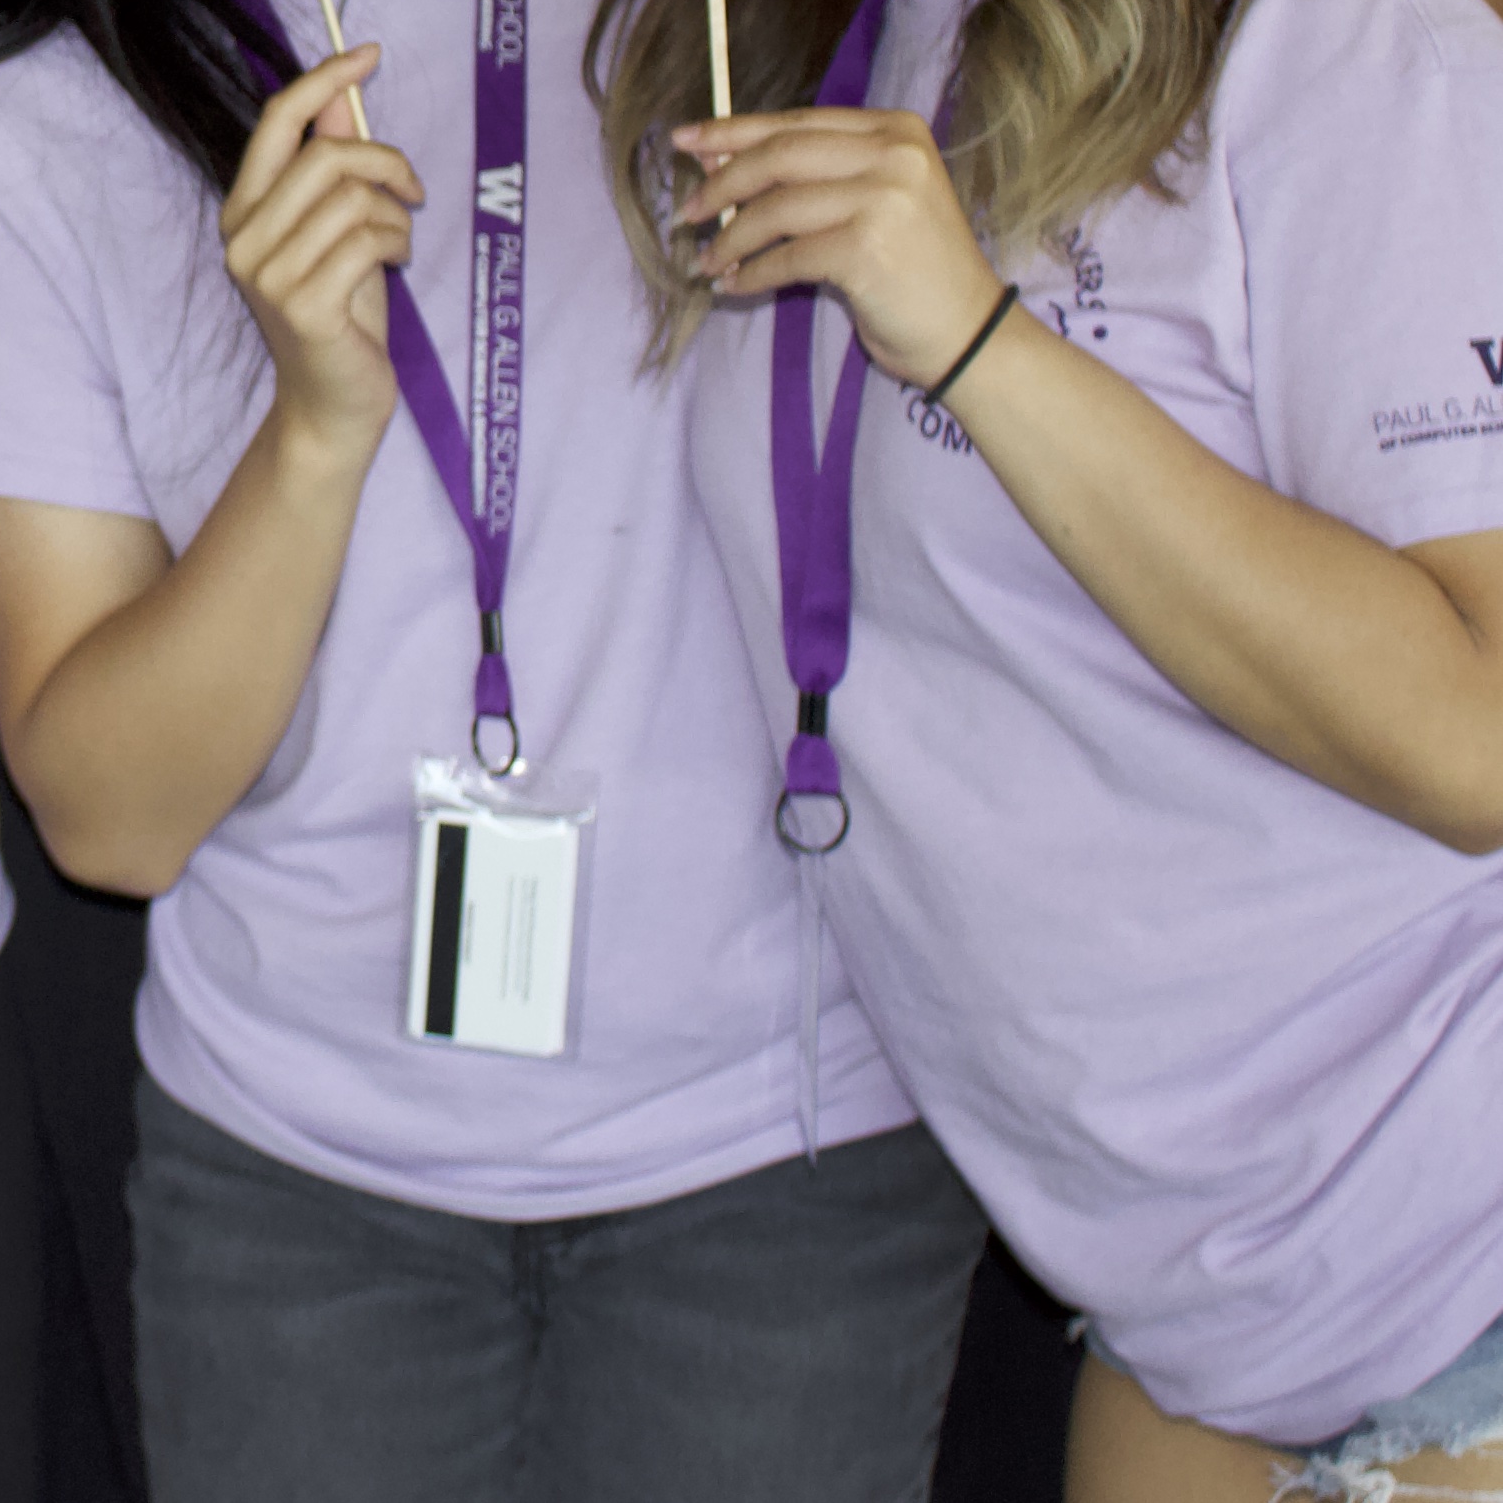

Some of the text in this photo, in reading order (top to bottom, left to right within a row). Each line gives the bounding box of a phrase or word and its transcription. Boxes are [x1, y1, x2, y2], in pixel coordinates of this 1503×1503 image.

[477, 162, 523, 225] W
[492, 232, 522, 301] PAUL
[491, 333, 520, 424] ALLEN
[1372, 404, 1440, 434] PAUL
[489, 426, 518, 538] SCHOOL
